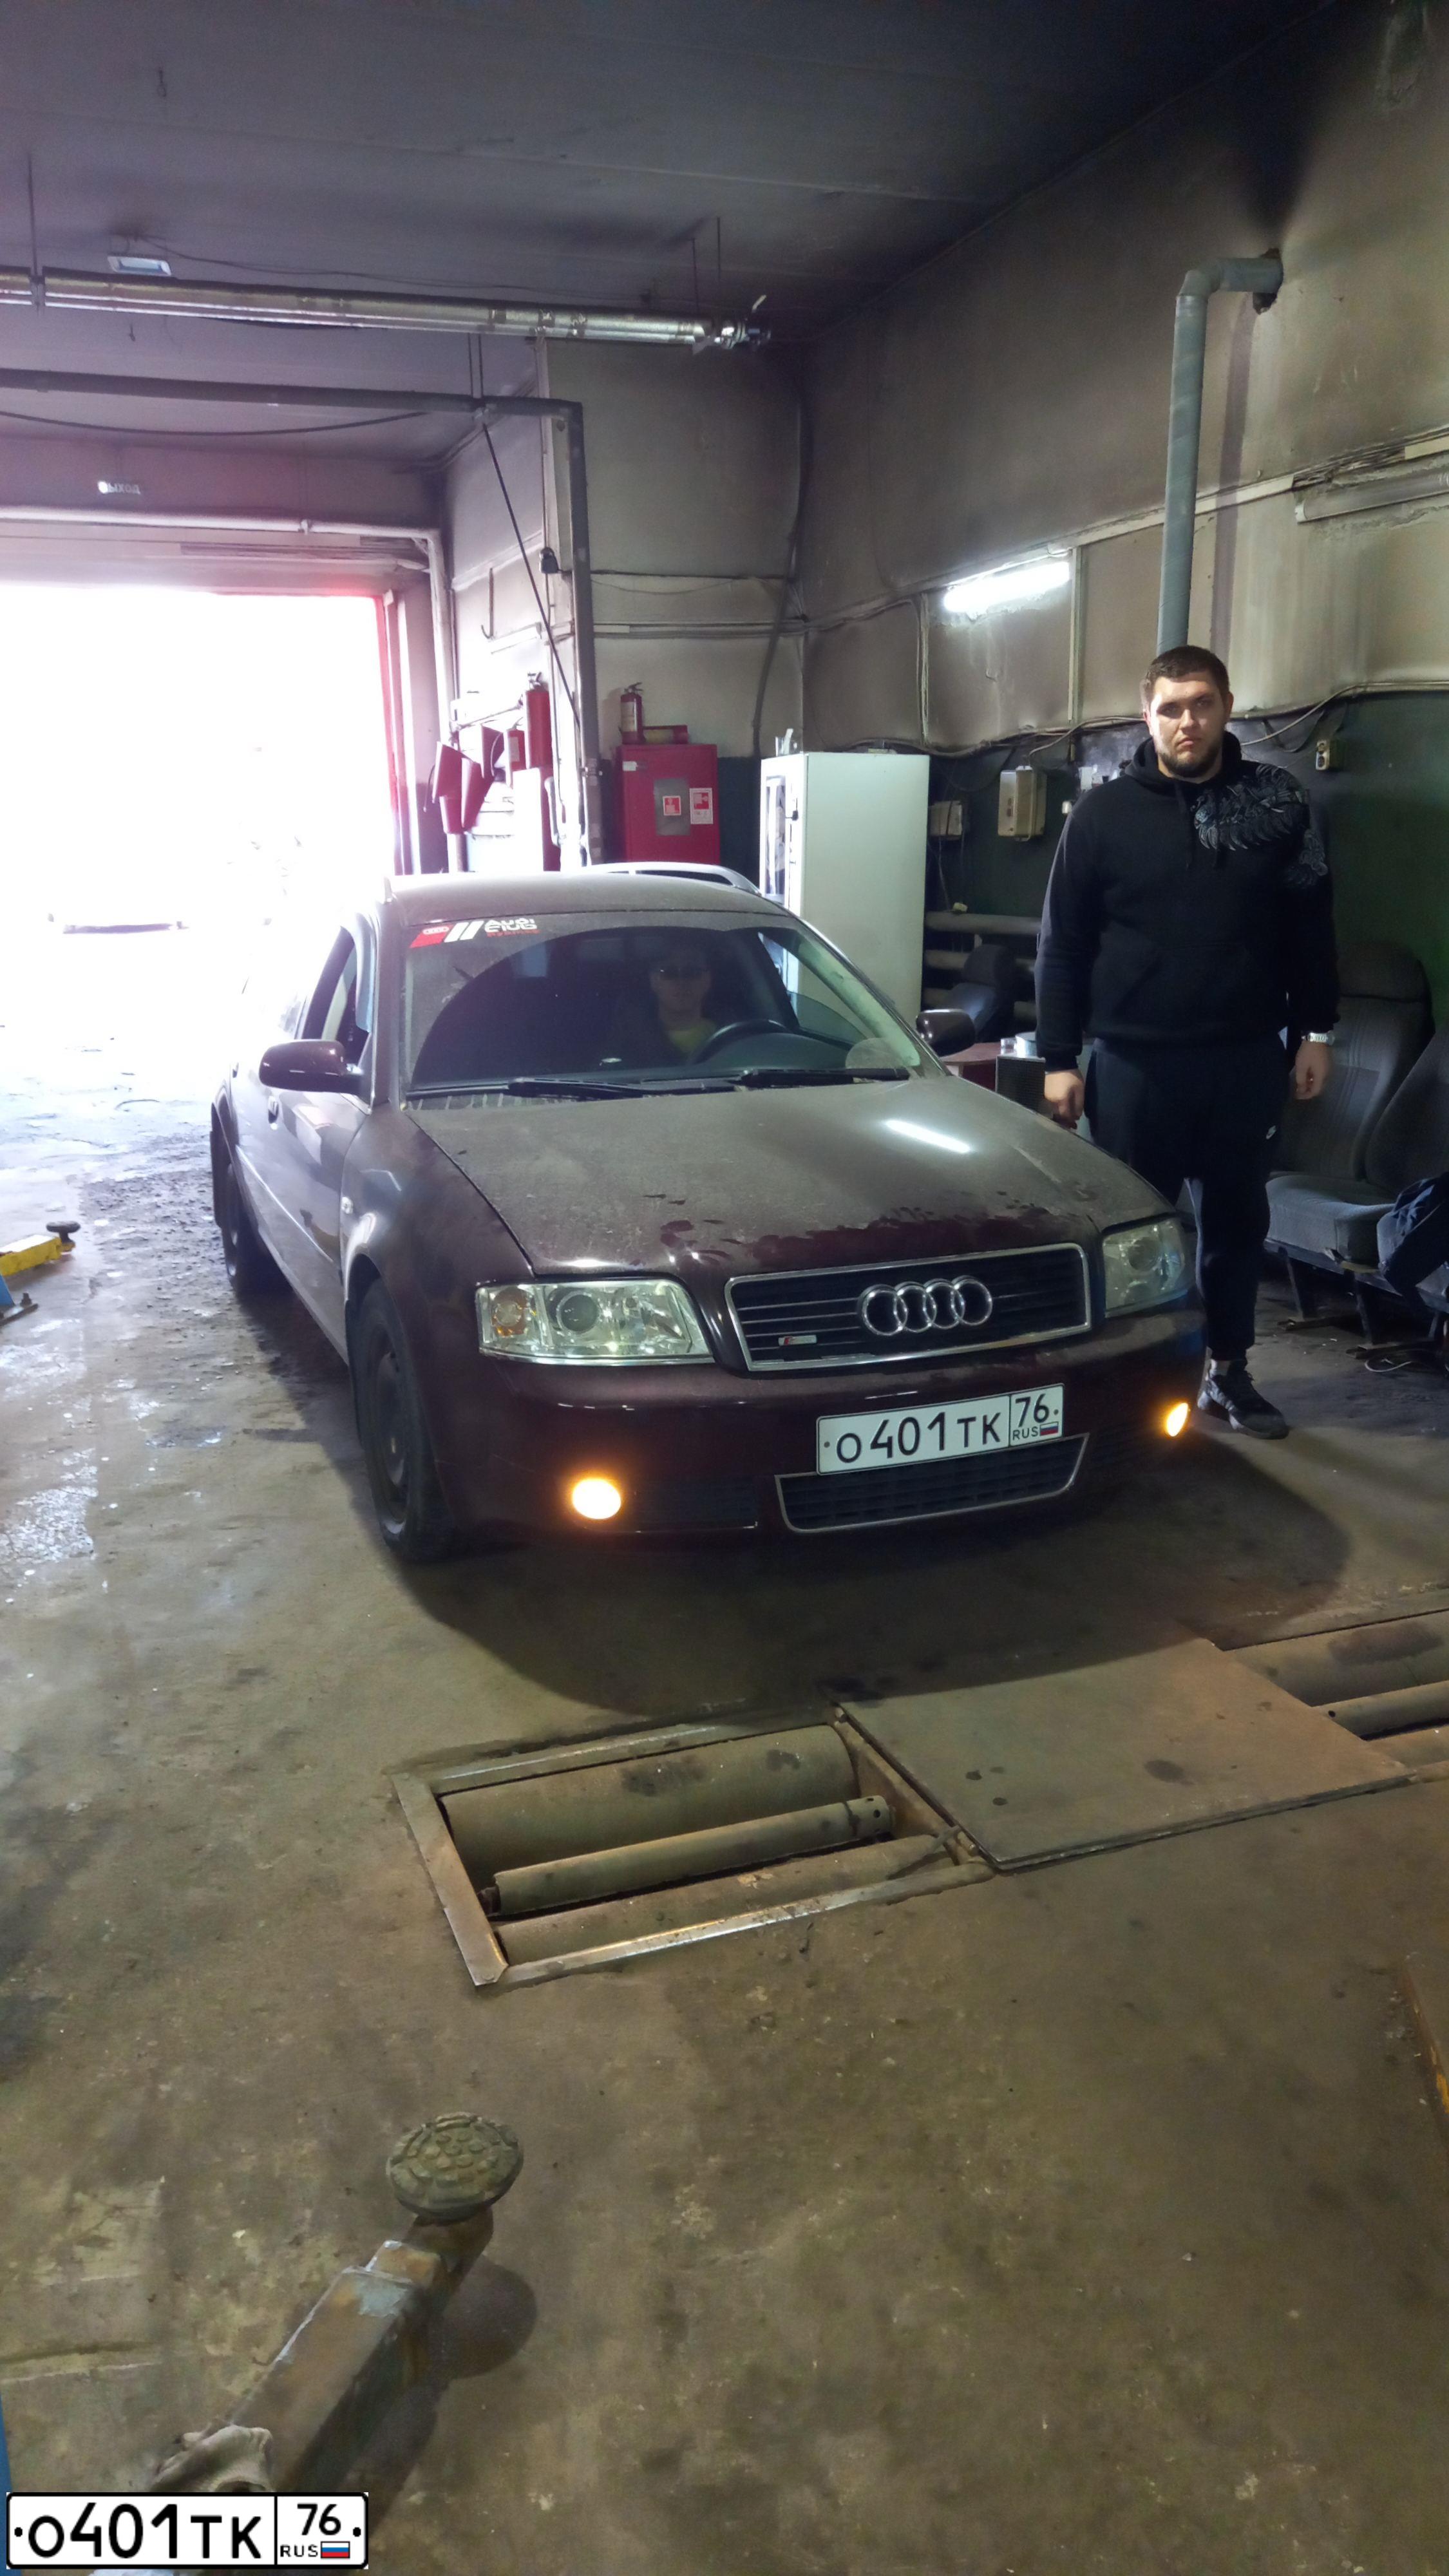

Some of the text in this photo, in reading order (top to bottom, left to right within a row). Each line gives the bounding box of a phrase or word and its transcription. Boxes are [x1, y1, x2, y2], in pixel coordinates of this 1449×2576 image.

[98, 482, 141, 495] ЫХОД
[1015, 1393, 1050, 1428] 76
[1012, 1425, 1039, 1441] RUS
